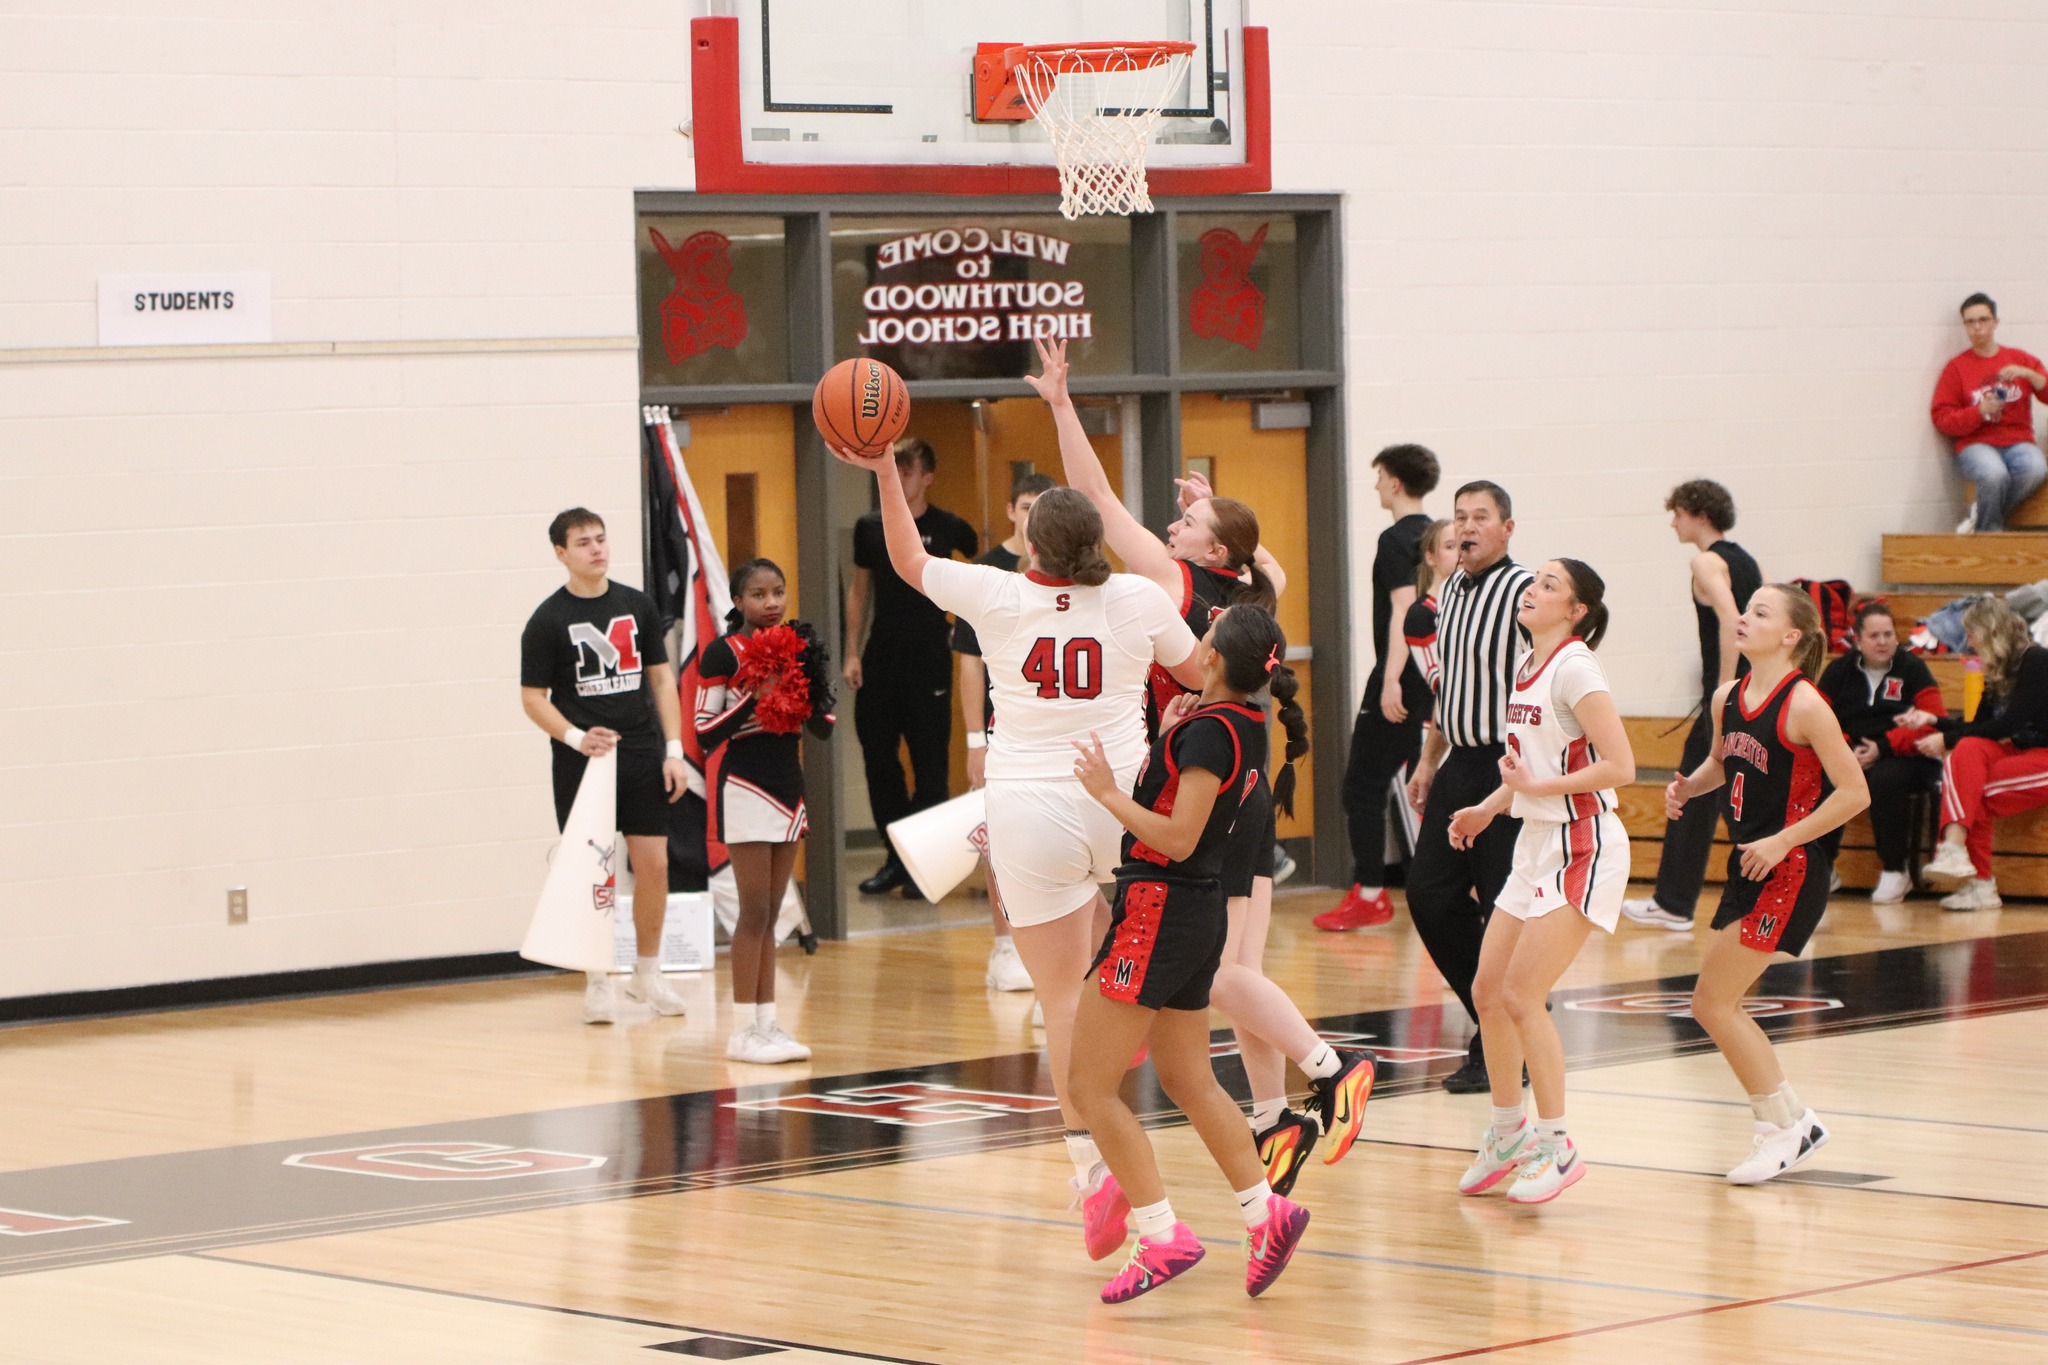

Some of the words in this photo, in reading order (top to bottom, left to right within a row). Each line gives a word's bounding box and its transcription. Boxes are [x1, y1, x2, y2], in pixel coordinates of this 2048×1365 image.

[134, 291, 235, 311] STUDENTS
[861, 362, 881, 419] Wilson
[1055, 593, 1071, 612] S
[568, 614, 642, 682] M
[1021, 637, 1103, 700] 40
[1730, 772, 1745, 822] 4
[1757, 913, 1777, 939] M
[1114, 957, 1134, 987] M
